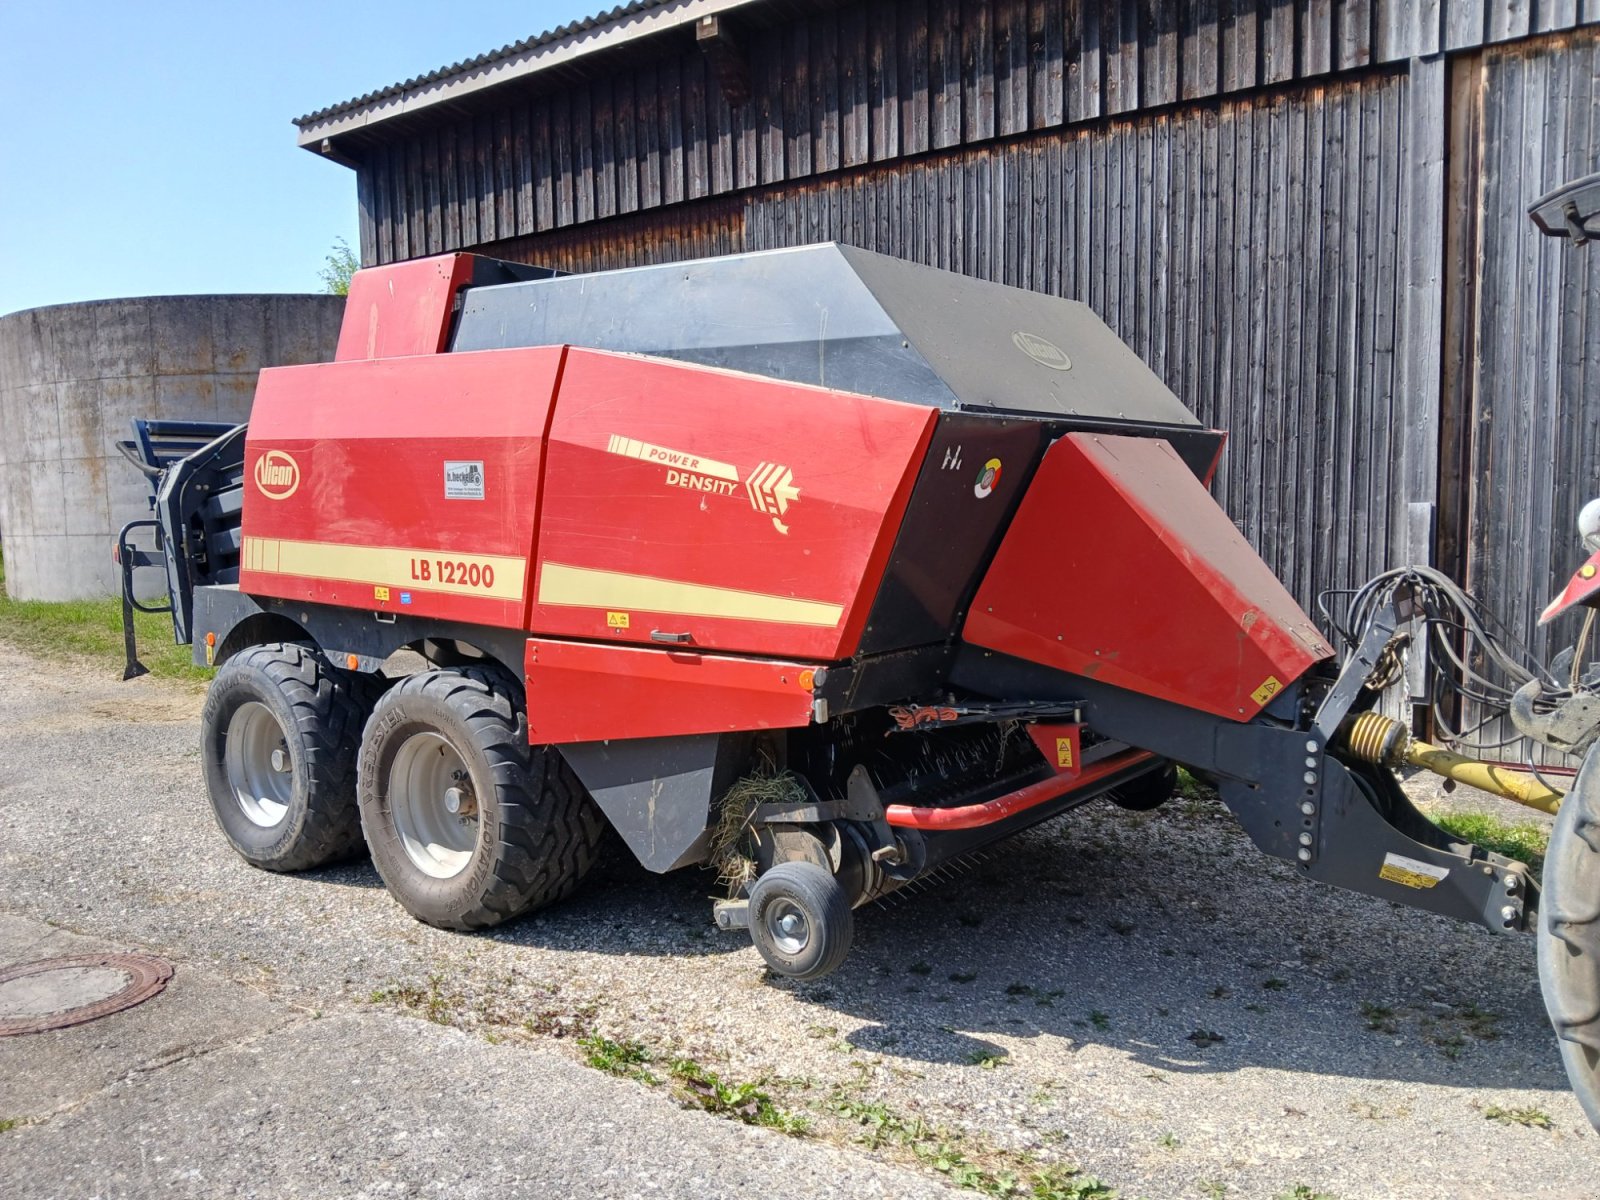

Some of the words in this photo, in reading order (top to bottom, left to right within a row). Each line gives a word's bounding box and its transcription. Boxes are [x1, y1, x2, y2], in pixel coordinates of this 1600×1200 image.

[258, 451, 294, 487] Vicon
[649, 449, 701, 468] POWER
[667, 470, 738, 495] DENSITY
[411, 557, 431, 581] LB
[436, 562, 494, 588] 12200
[462, 808, 496, 903] FLOTATION
